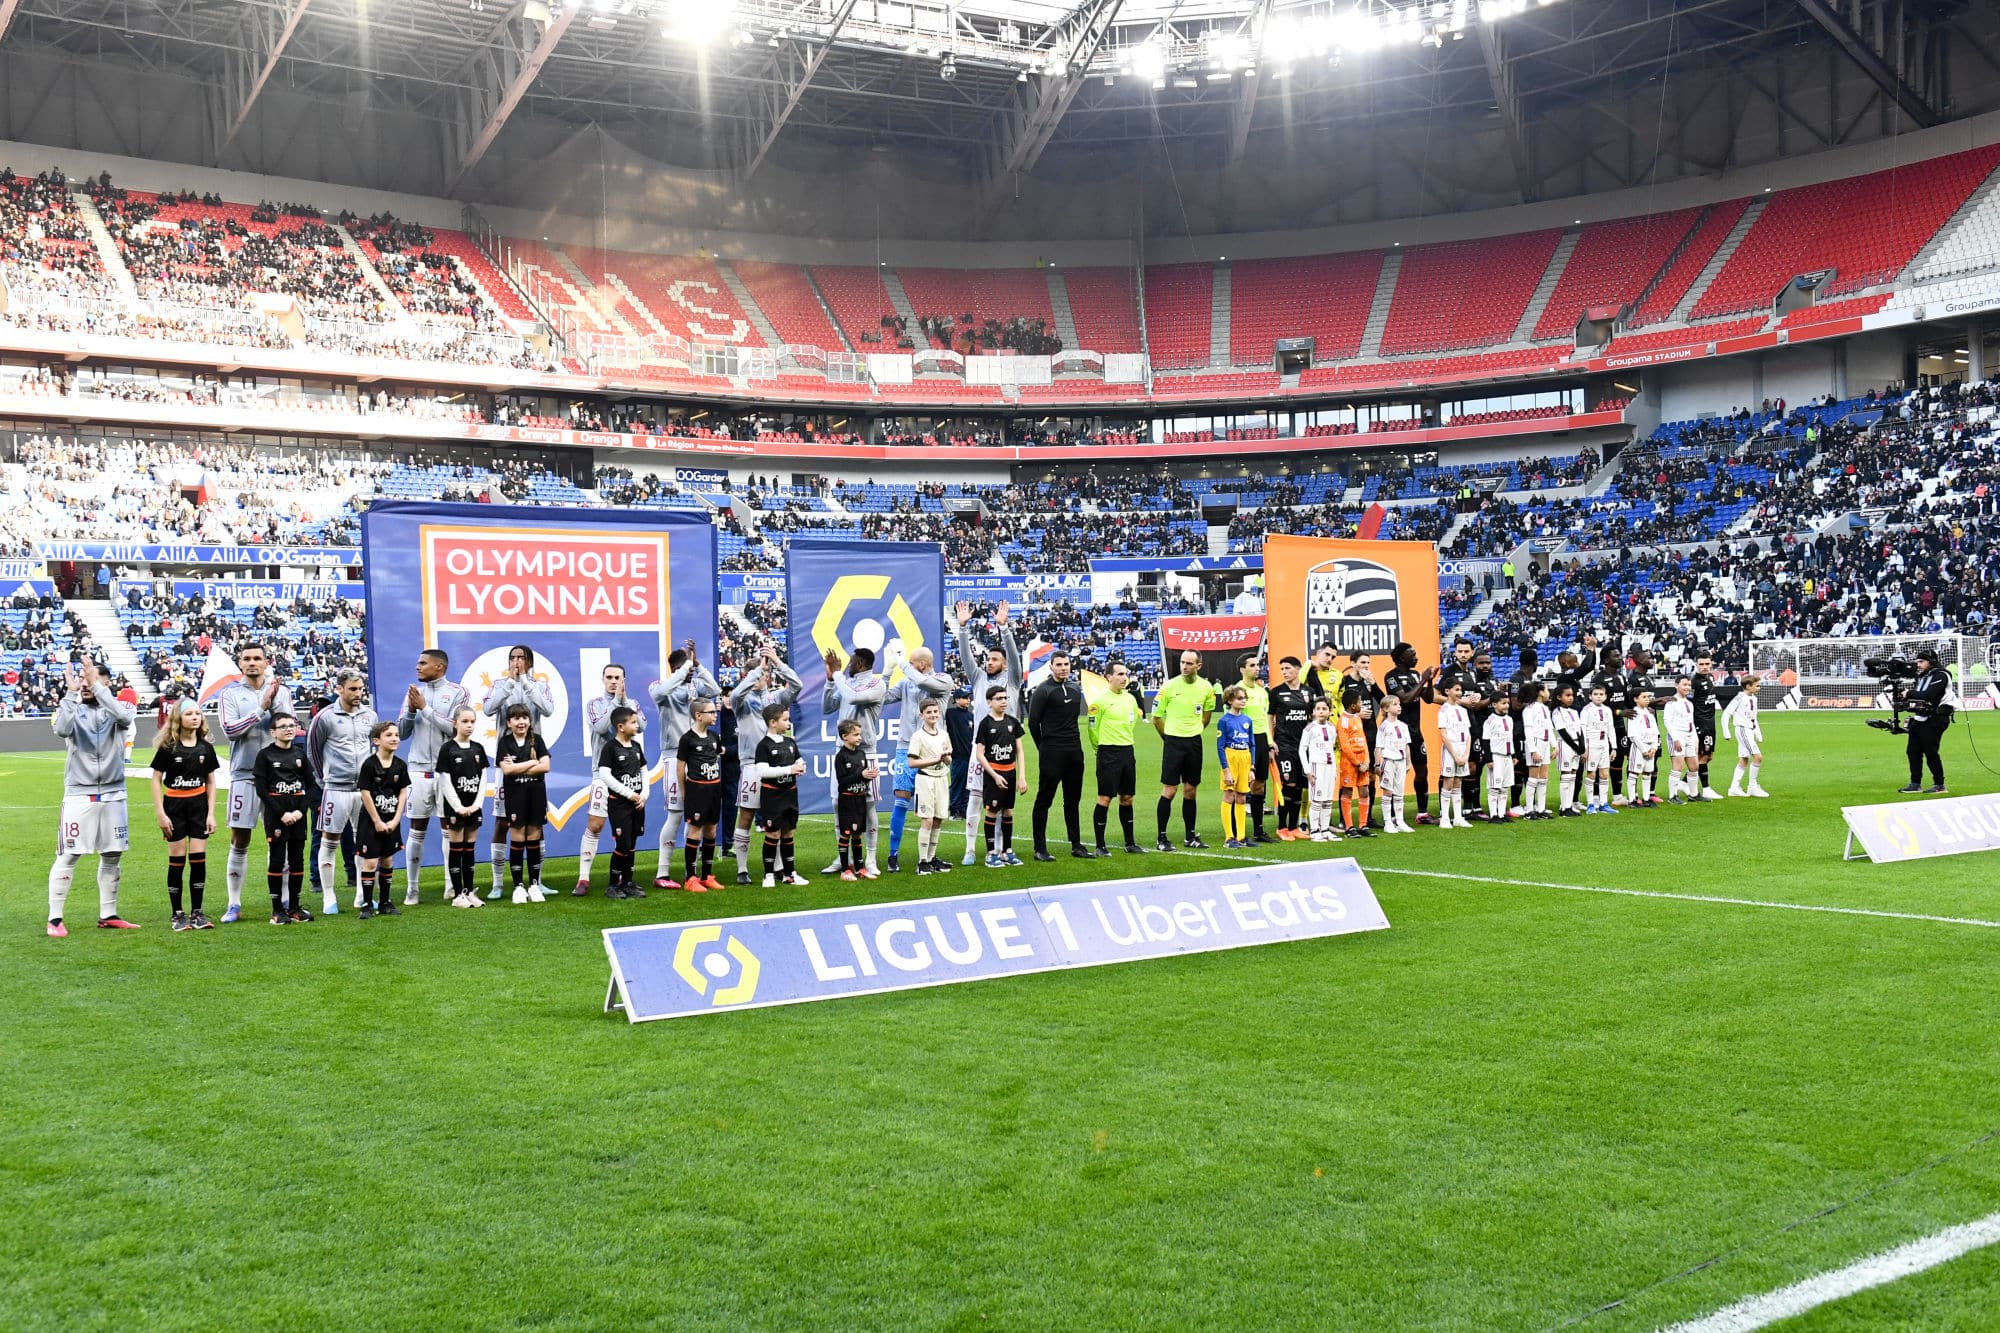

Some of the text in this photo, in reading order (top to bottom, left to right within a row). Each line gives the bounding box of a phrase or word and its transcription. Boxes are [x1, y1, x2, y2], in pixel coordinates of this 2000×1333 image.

[1606, 350, 1691, 367] Groupama STADIUM
[518, 430, 560, 441] Orange
[581, 432, 620, 445] Orange
[258, 548, 341, 564] OOGarden
[446, 548, 648, 583] OLYMPIQUE
[743, 575, 785, 587] Orange
[204, 584, 337, 600] Emirates FLY BETTER
[448, 583, 649, 616] LYONNAIS
[1168, 626, 1260, 637] Emirates
[1204, 634, 1246, 643] BETTER
[1310, 624, 1397, 650] FC LORIENT
[1808, 697, 1853, 708] Orange
[1280, 760, 1292, 773] 19
[594, 786, 603, 800] 6
[669, 782, 677, 795] 4
[741, 780, 757, 794] 24
[233, 795, 243, 810] 5
[324, 801, 334, 816] 3
[64, 822, 80, 838] 18
[1921, 803, 2000, 844] LIGU
[799, 880, 1348, 982] LIGUE 1 Uber Eats
